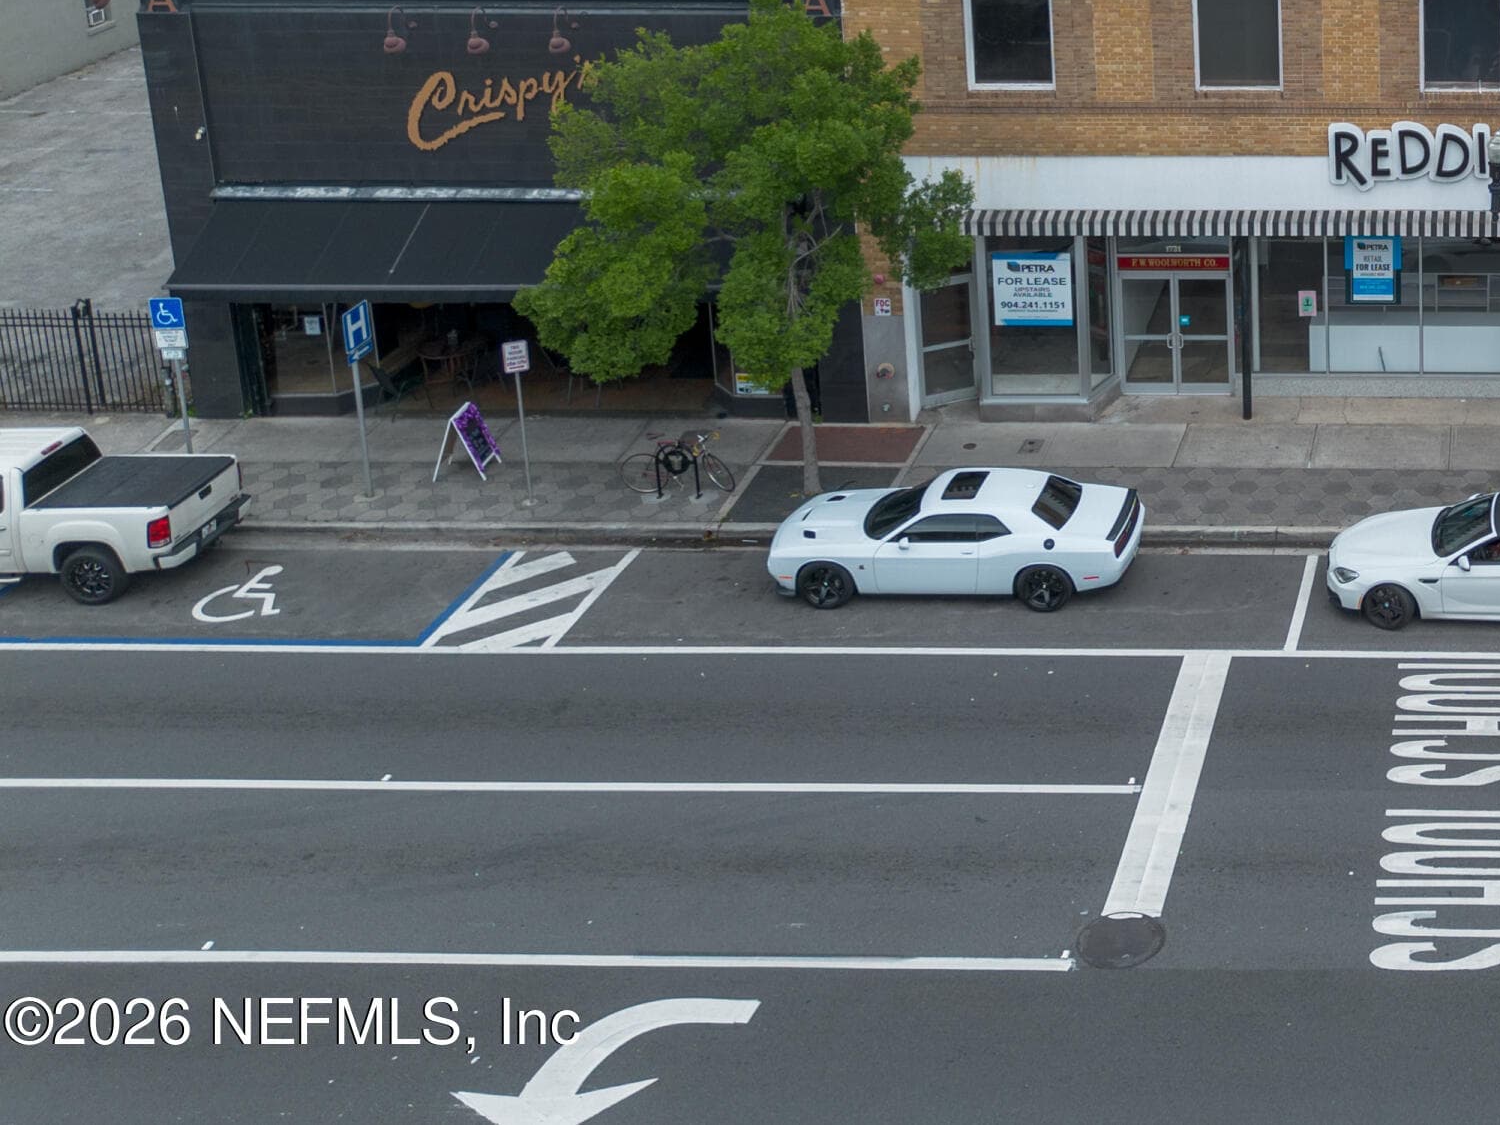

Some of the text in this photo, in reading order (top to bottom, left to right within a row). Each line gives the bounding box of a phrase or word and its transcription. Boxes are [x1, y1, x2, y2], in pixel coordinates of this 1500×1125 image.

[1334, 129, 1487, 186] REDDI
[1021, 264, 1055, 273] PETRA
[1356, 263, 1391, 271] FOR LEASE
[998, 277, 1067, 286] FOR LEASE
[1000, 301, 1065, 309] 904.241.1151
[346, 305, 368, 349] H
